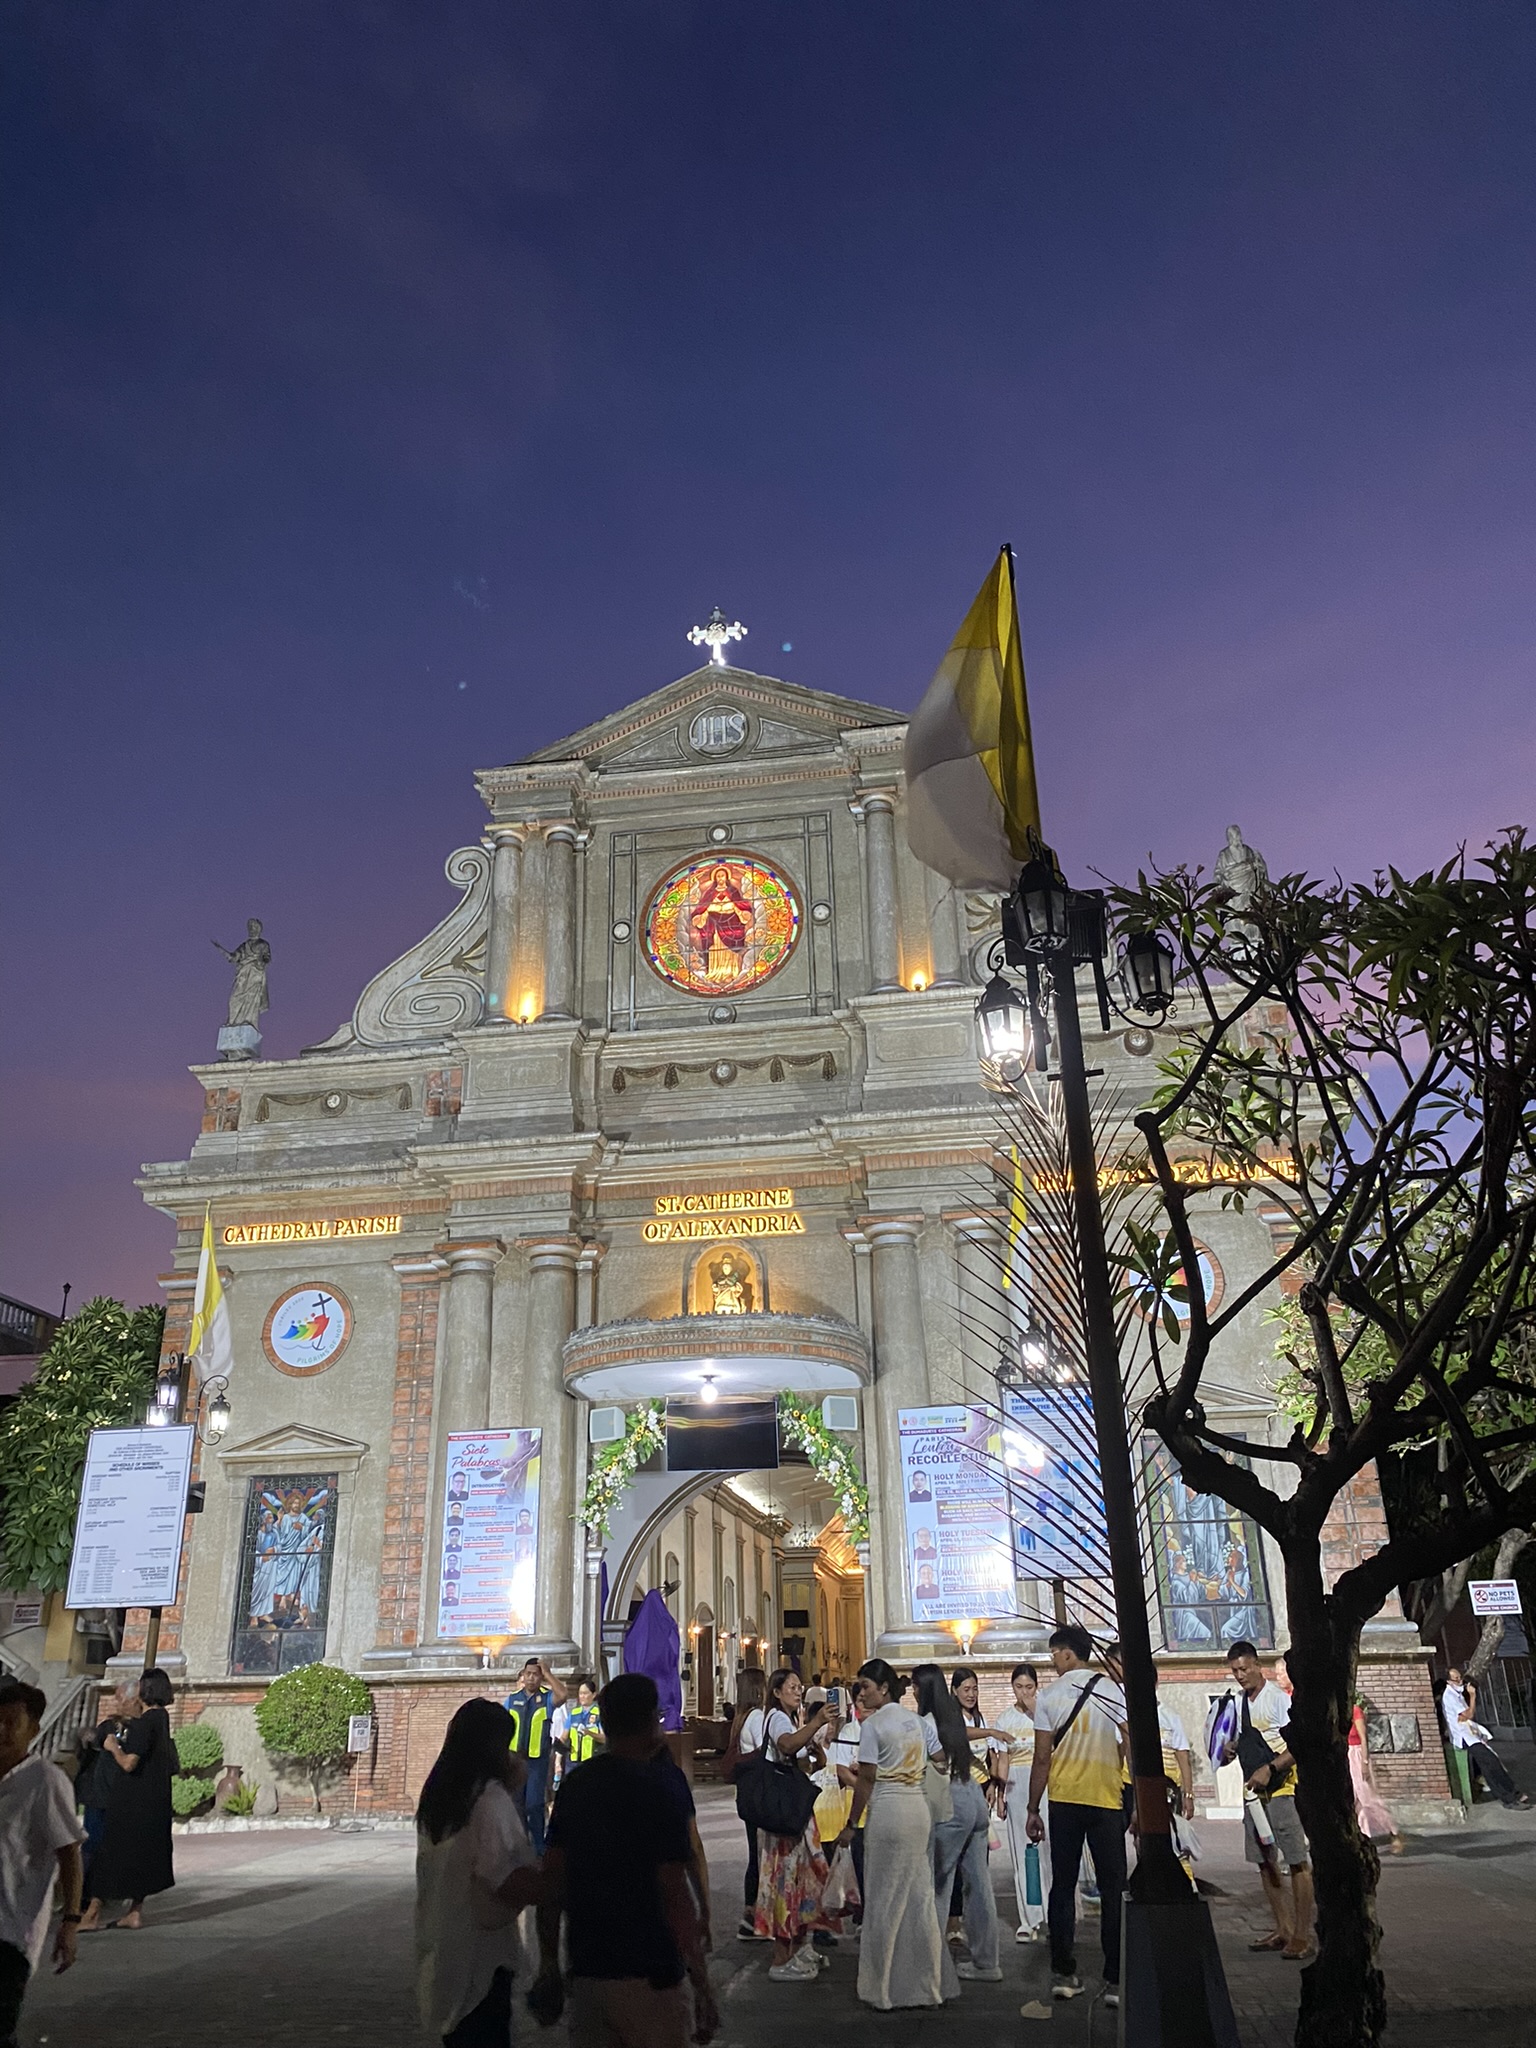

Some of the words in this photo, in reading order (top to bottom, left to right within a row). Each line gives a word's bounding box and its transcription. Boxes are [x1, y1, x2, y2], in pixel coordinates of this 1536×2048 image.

[657, 1196, 681, 1214] ST.
[683, 1189, 791, 1211] CATHERINE
[224, 1221, 328, 1243] CATHEDRAL
[333, 1216, 399, 1236] PARISH
[644, 1223, 670, 1240] OF
[671, 1214, 802, 1238] ALEXANDRIA
[296, 1349, 331, 1365] PILGRIMS
[329, 1340, 338, 1350] OF
[335, 1319, 343, 1340] HOPE
[462, 1443, 489, 1456] Siete
[912, 1438, 955, 1455] Lenten
[452, 1455, 501, 1469] Palabras
[908, 1452, 996, 1466] RECOLLECTION
[934, 1473, 954, 1481] HOLY
[955, 1472, 989, 1480] MONDAY
[939, 1530, 959, 1538] HOLY
